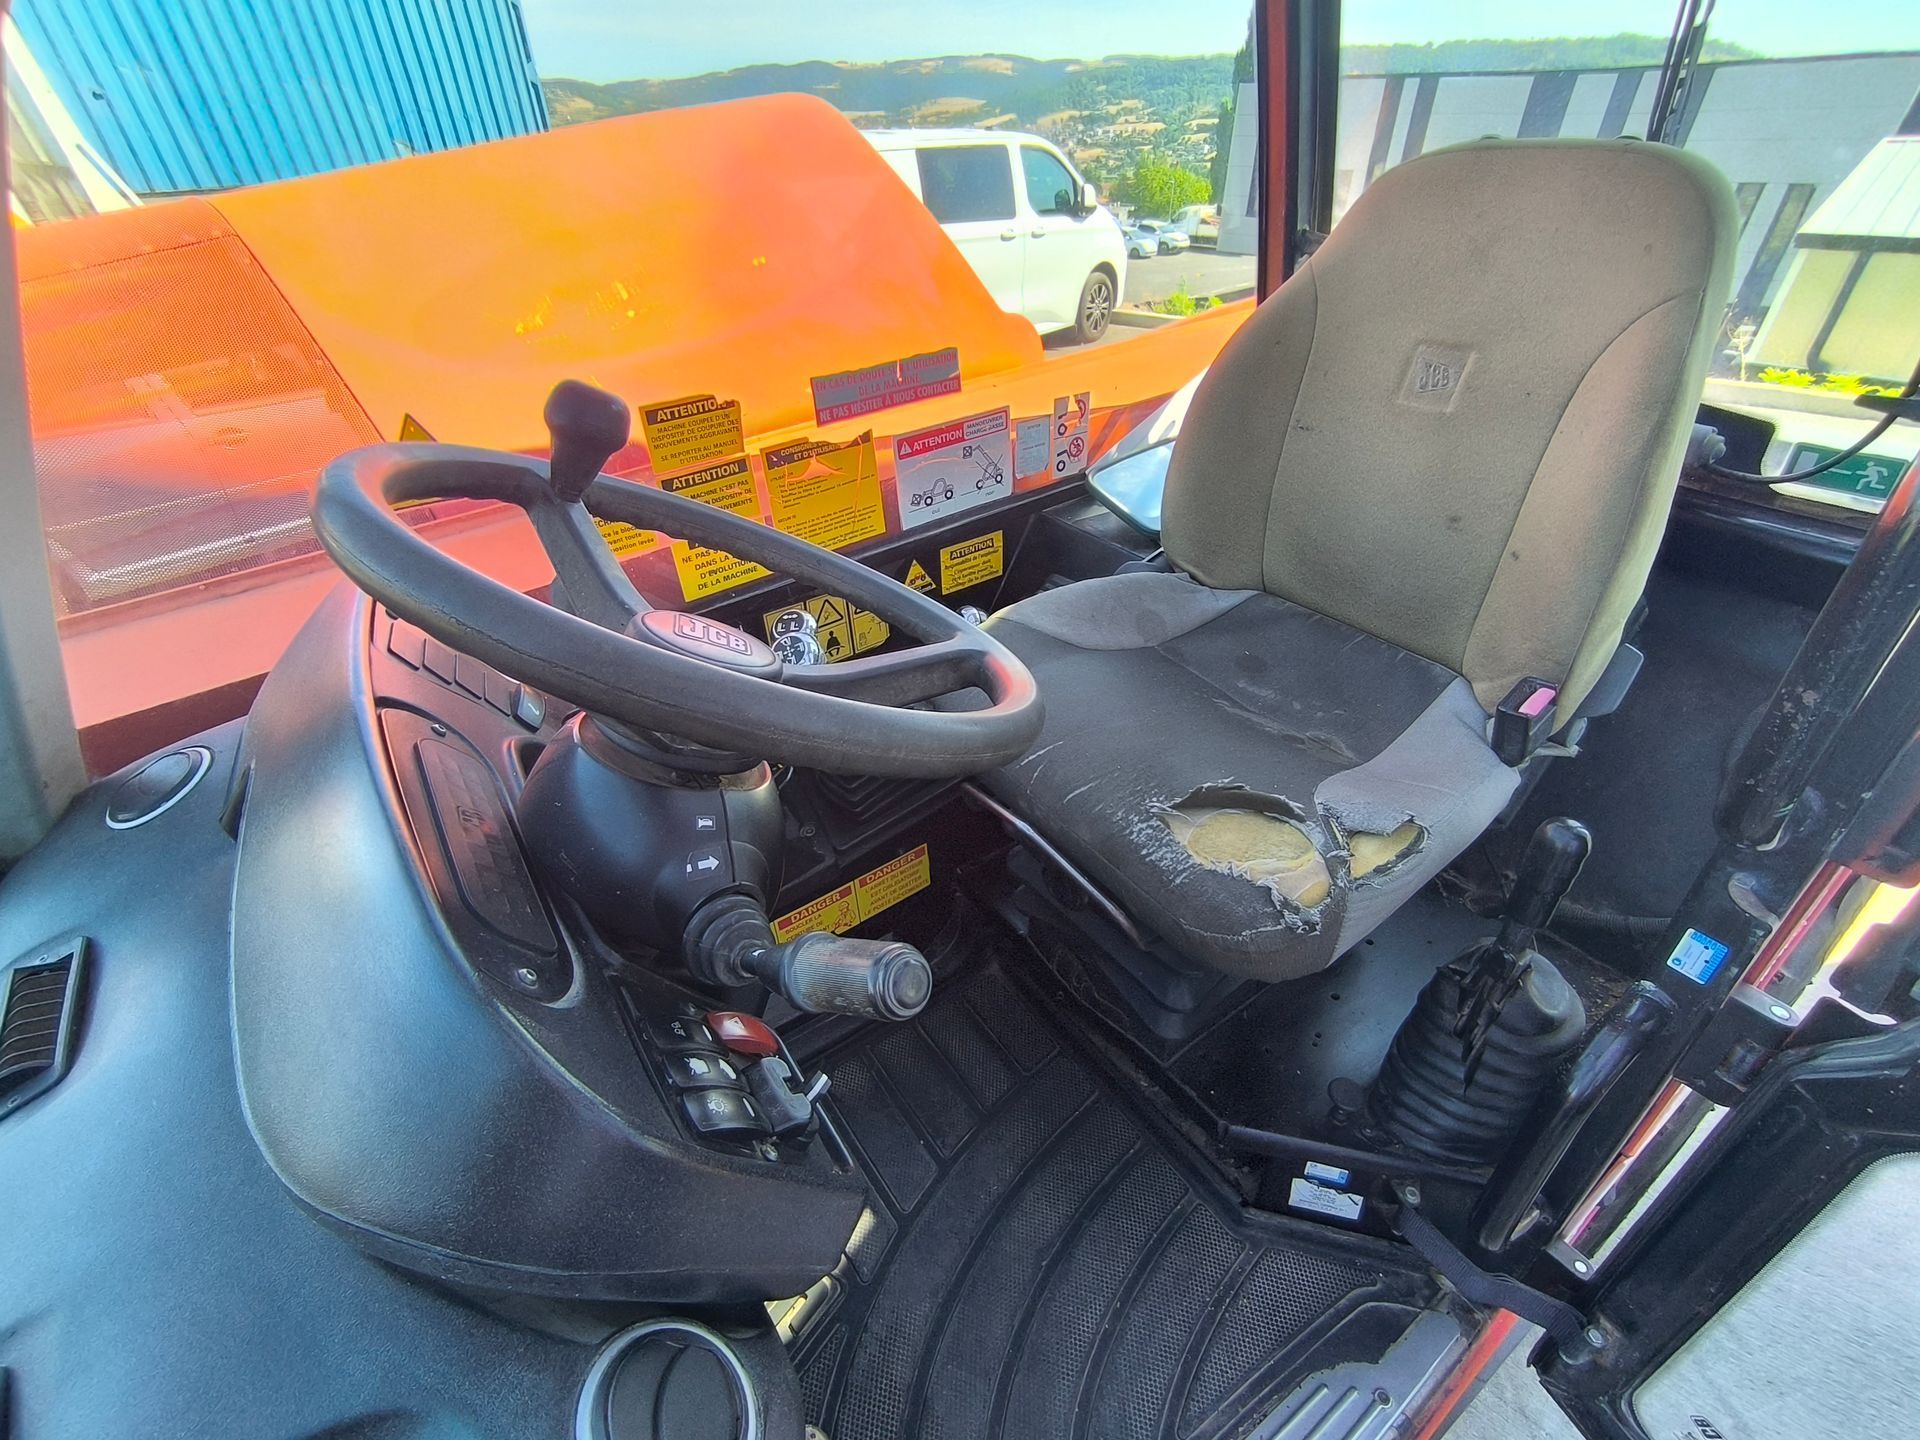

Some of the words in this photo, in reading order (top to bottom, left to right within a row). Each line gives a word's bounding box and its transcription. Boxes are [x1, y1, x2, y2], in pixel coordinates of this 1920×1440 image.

[1418, 361, 1450, 391] JCB
[819, 409, 832, 423] NE
[833, 405, 849, 419] PAS
[894, 389, 916, 403] NOUS
[917, 380, 960, 397] CONTACTER
[651, 431, 685, 443] DISPOSITIF
[687, 427, 696, 435] DE
[697, 421, 726, 432] COUPURE
[726, 418, 739, 426] DES
[653, 435, 699, 450] MOUVEMENTS
[699, 426, 740, 440] AGGRAVANTS
[657, 421, 687, 434] MACHINE
[670, 446, 702, 460] REPORTER
[703, 444, 712, 452] AU
[713, 438, 739, 450] MANUEL
[912, 429, 963, 452] ATTENTION
[680, 449, 724, 465] D'UTILISATION
[794, 452, 802, 461] ET
[672, 463, 740, 490] ATTENTION
[690, 487, 718, 500] MACHINE
[738, 479, 749, 487] PAS
[625, 532, 642, 541] toute
[682, 555, 693, 564] NE
[695, 550, 711, 559] PAS
[951, 540, 993, 560] ATTENTION
[695, 557, 718, 571] DANS
[720, 554, 730, 562] LA
[698, 582, 710, 591] DE
[711, 578, 721, 586] LA
[723, 565, 758, 582] MACHINE
[681, 618, 747, 649] JCB
[866, 854, 916, 884] DANGER
[791, 893, 841, 923] DANGER
[785, 917, 813, 935] BOUCLER
[813, 913, 822, 922] LA
